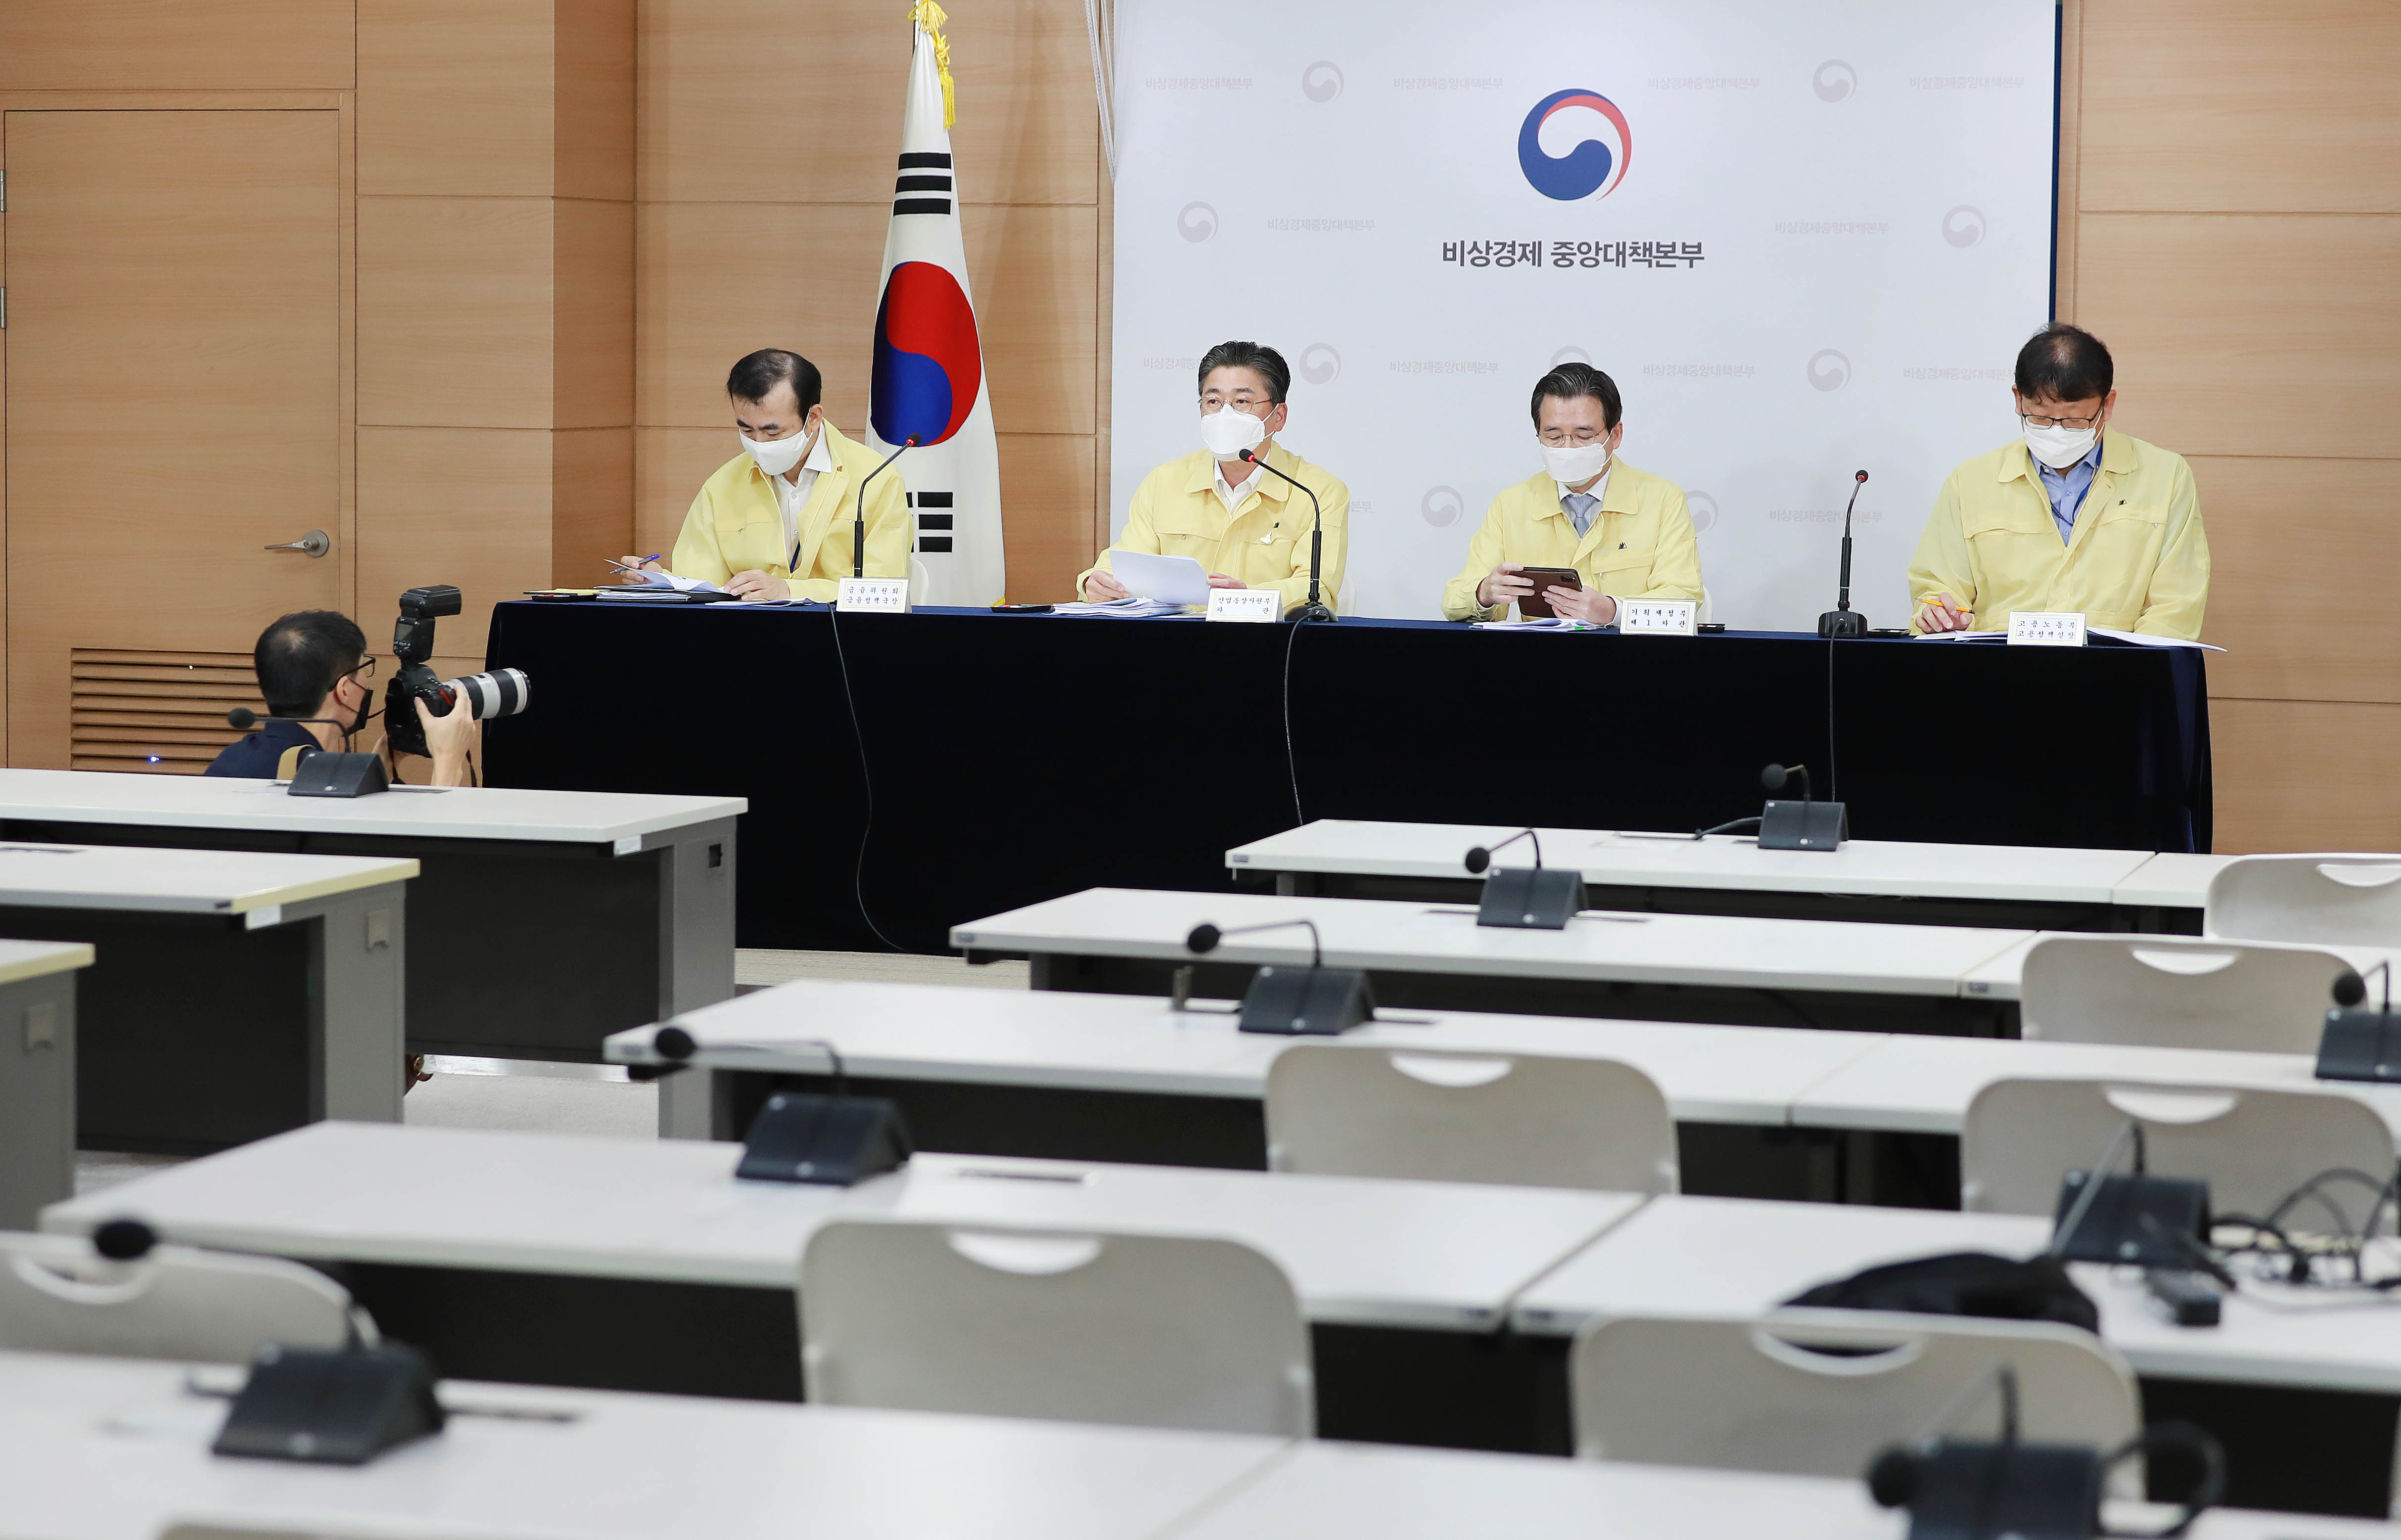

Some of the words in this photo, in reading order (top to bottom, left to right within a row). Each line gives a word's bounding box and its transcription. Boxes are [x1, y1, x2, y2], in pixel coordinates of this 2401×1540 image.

[1145, 77, 1253, 90] 비상경제중앙대책본부
[1393, 77, 1503, 90] 비상경제중앙대책본부
[1648, 77, 1760, 90] 비상경제중앙대책본부
[1909, 76, 2025, 90] 비상경제중앙대책본부
[1268, 218, 1375, 231] 비상경제중앙대책본부
[1775, 221, 1889, 234] 비상경제중앙대책본부
[1442, 240, 1542, 268] 비상경제
[1550, 241, 1705, 269] 중앙대책본부
[1389, 360, 1499, 374] 비상경제중앙대책본부
[1643, 363, 1755, 377] 비상경제중앙대책본부
